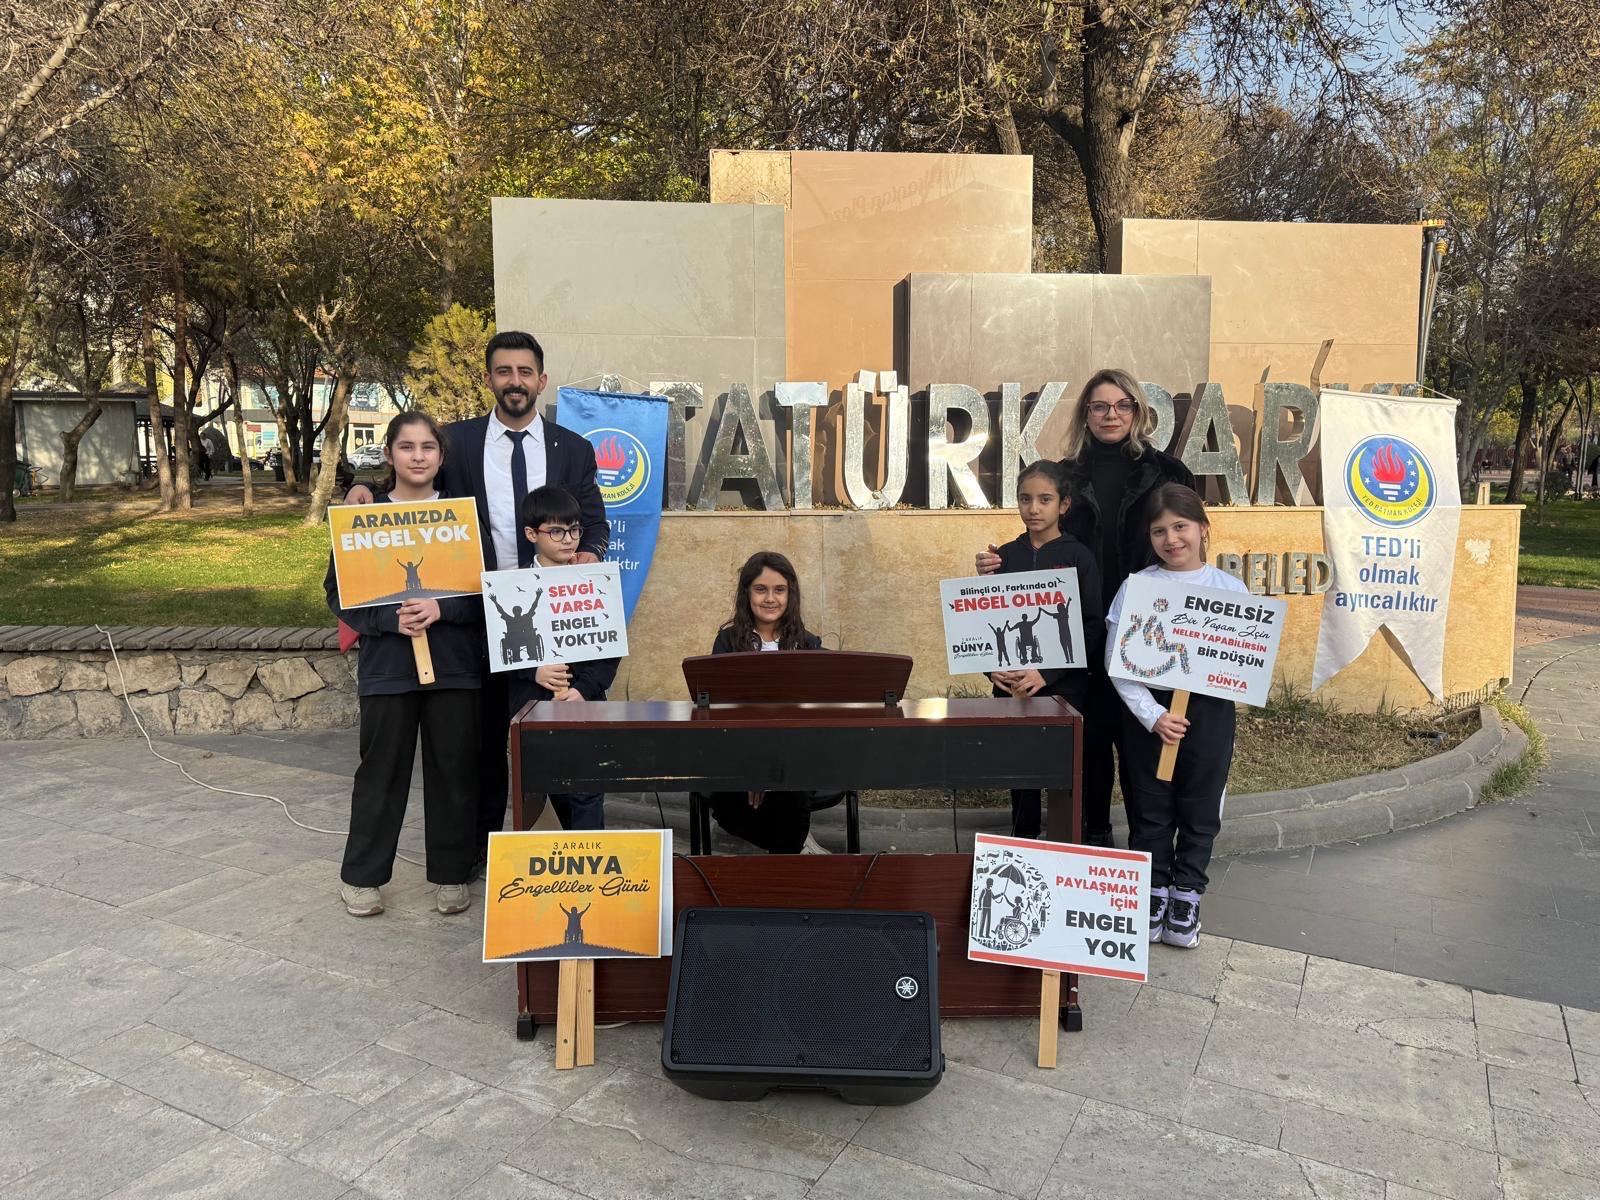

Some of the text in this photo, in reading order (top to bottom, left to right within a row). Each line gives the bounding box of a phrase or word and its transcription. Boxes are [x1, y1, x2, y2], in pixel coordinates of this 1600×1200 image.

[600, 370, 1068, 510] TATÜRK
[351, 508, 458, 529] ARAMIZDA
[340, 524, 472, 552] ENGEL YOK
[1359, 563, 1420, 585] olmak
[548, 580, 594, 598] SEVGİ
[960, 584, 990, 596] Bilinçli
[1006, 582, 1046, 592] Farkında
[1048, 580, 1057, 589] Ol
[550, 598, 605, 614] VARSA
[954, 591, 1067, 613] ENGEL OLMA
[1184, 595, 1275, 625] ENGELSİZ
[1335, 591, 1438, 612] ayrıcalıktır
[551, 616, 599, 632] ENGEL
[1170, 612, 1271, 640] Bir Yaşam İçin
[553, 630, 618, 649] YOKTUR
[952, 641, 994, 653] DÜNYA
[1172, 627, 1268, 653] NELER YAPABİLİRSİN
[1197, 645, 1265, 668] BİR DÜŞÜN
[1207, 673, 1248, 690] DÜNYA
[553, 841, 603, 850] 3 ARALIK
[528, 851, 622, 876] DÜNYA
[1088, 865, 1139, 882] HAYATI
[498, 876, 650, 903] Engelliler Günü
[1055, 875, 1139, 896] PAYLAŞMAK
[1110, 895, 1139, 912] İÇİN
[1065, 909, 1138, 935] ENGEL
[1085, 937, 1137, 962] YOK
